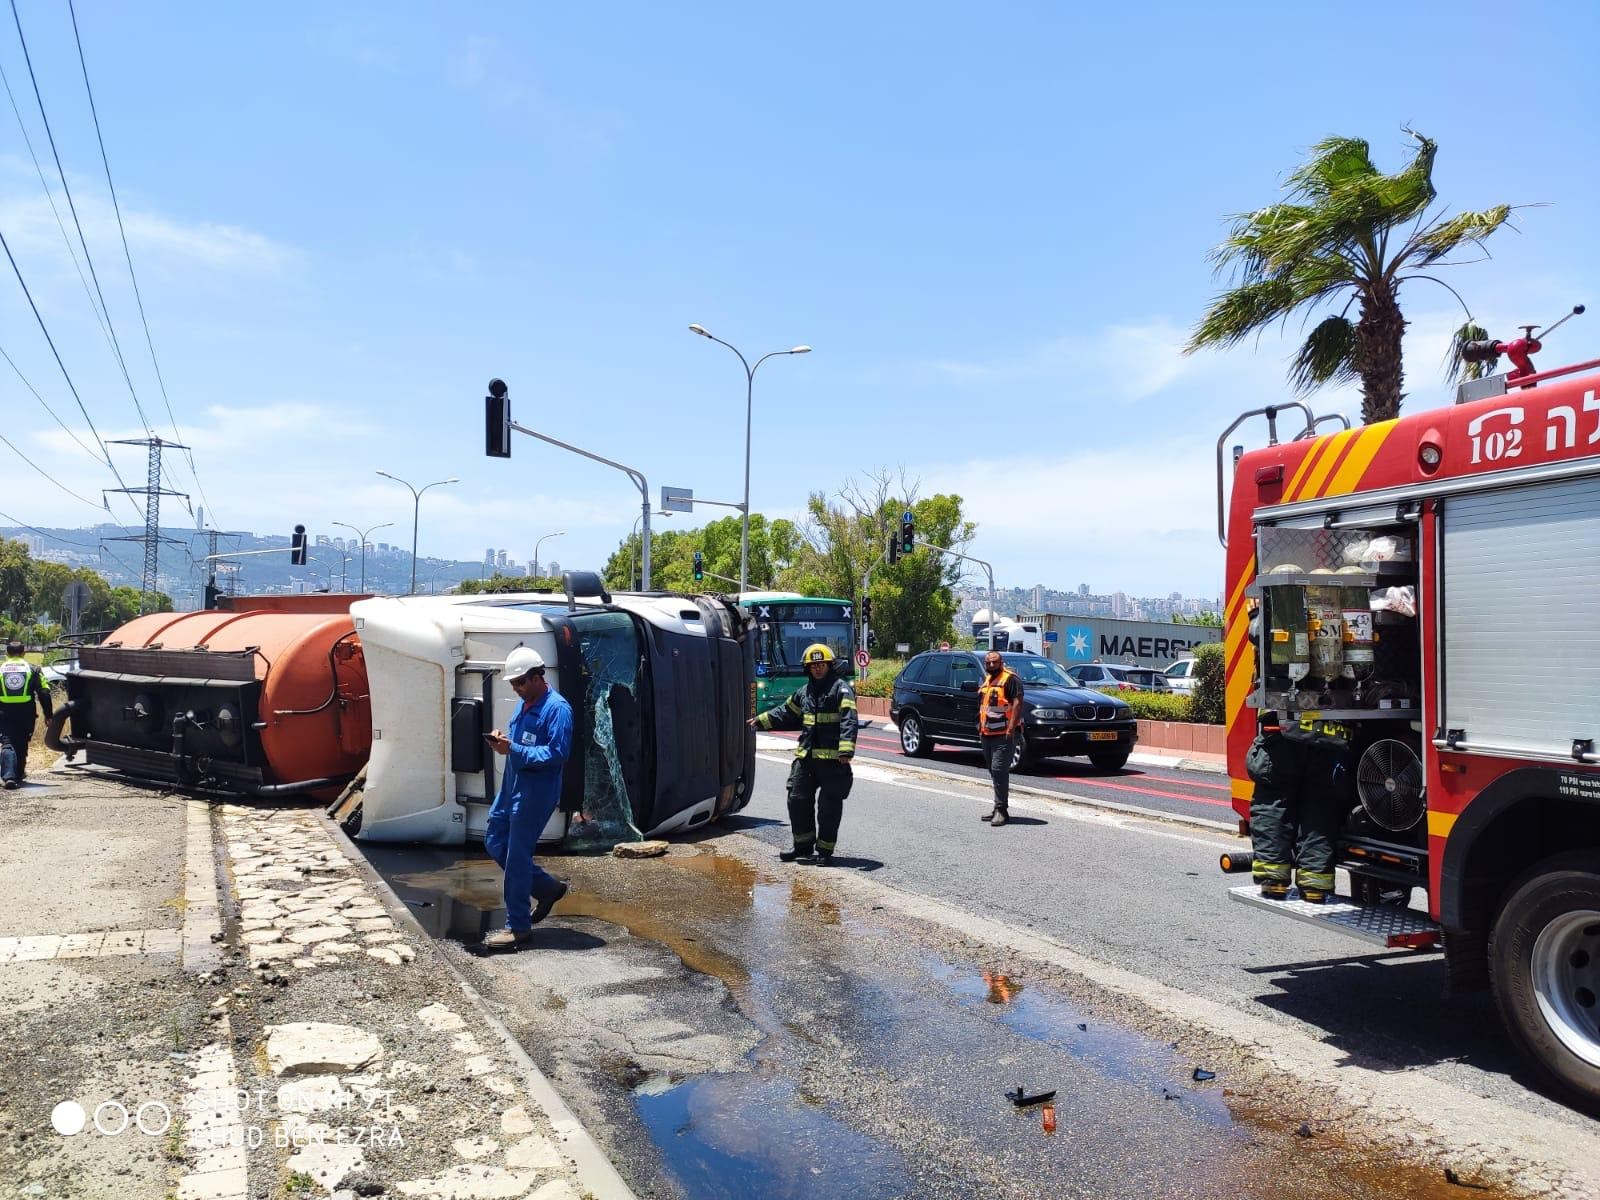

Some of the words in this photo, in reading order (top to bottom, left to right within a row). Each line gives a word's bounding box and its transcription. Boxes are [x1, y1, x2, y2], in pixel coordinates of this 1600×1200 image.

[1470, 429, 1523, 464] 102
[1568, 777, 1578, 785] PSI
[1569, 787, 1578, 795] PSI
